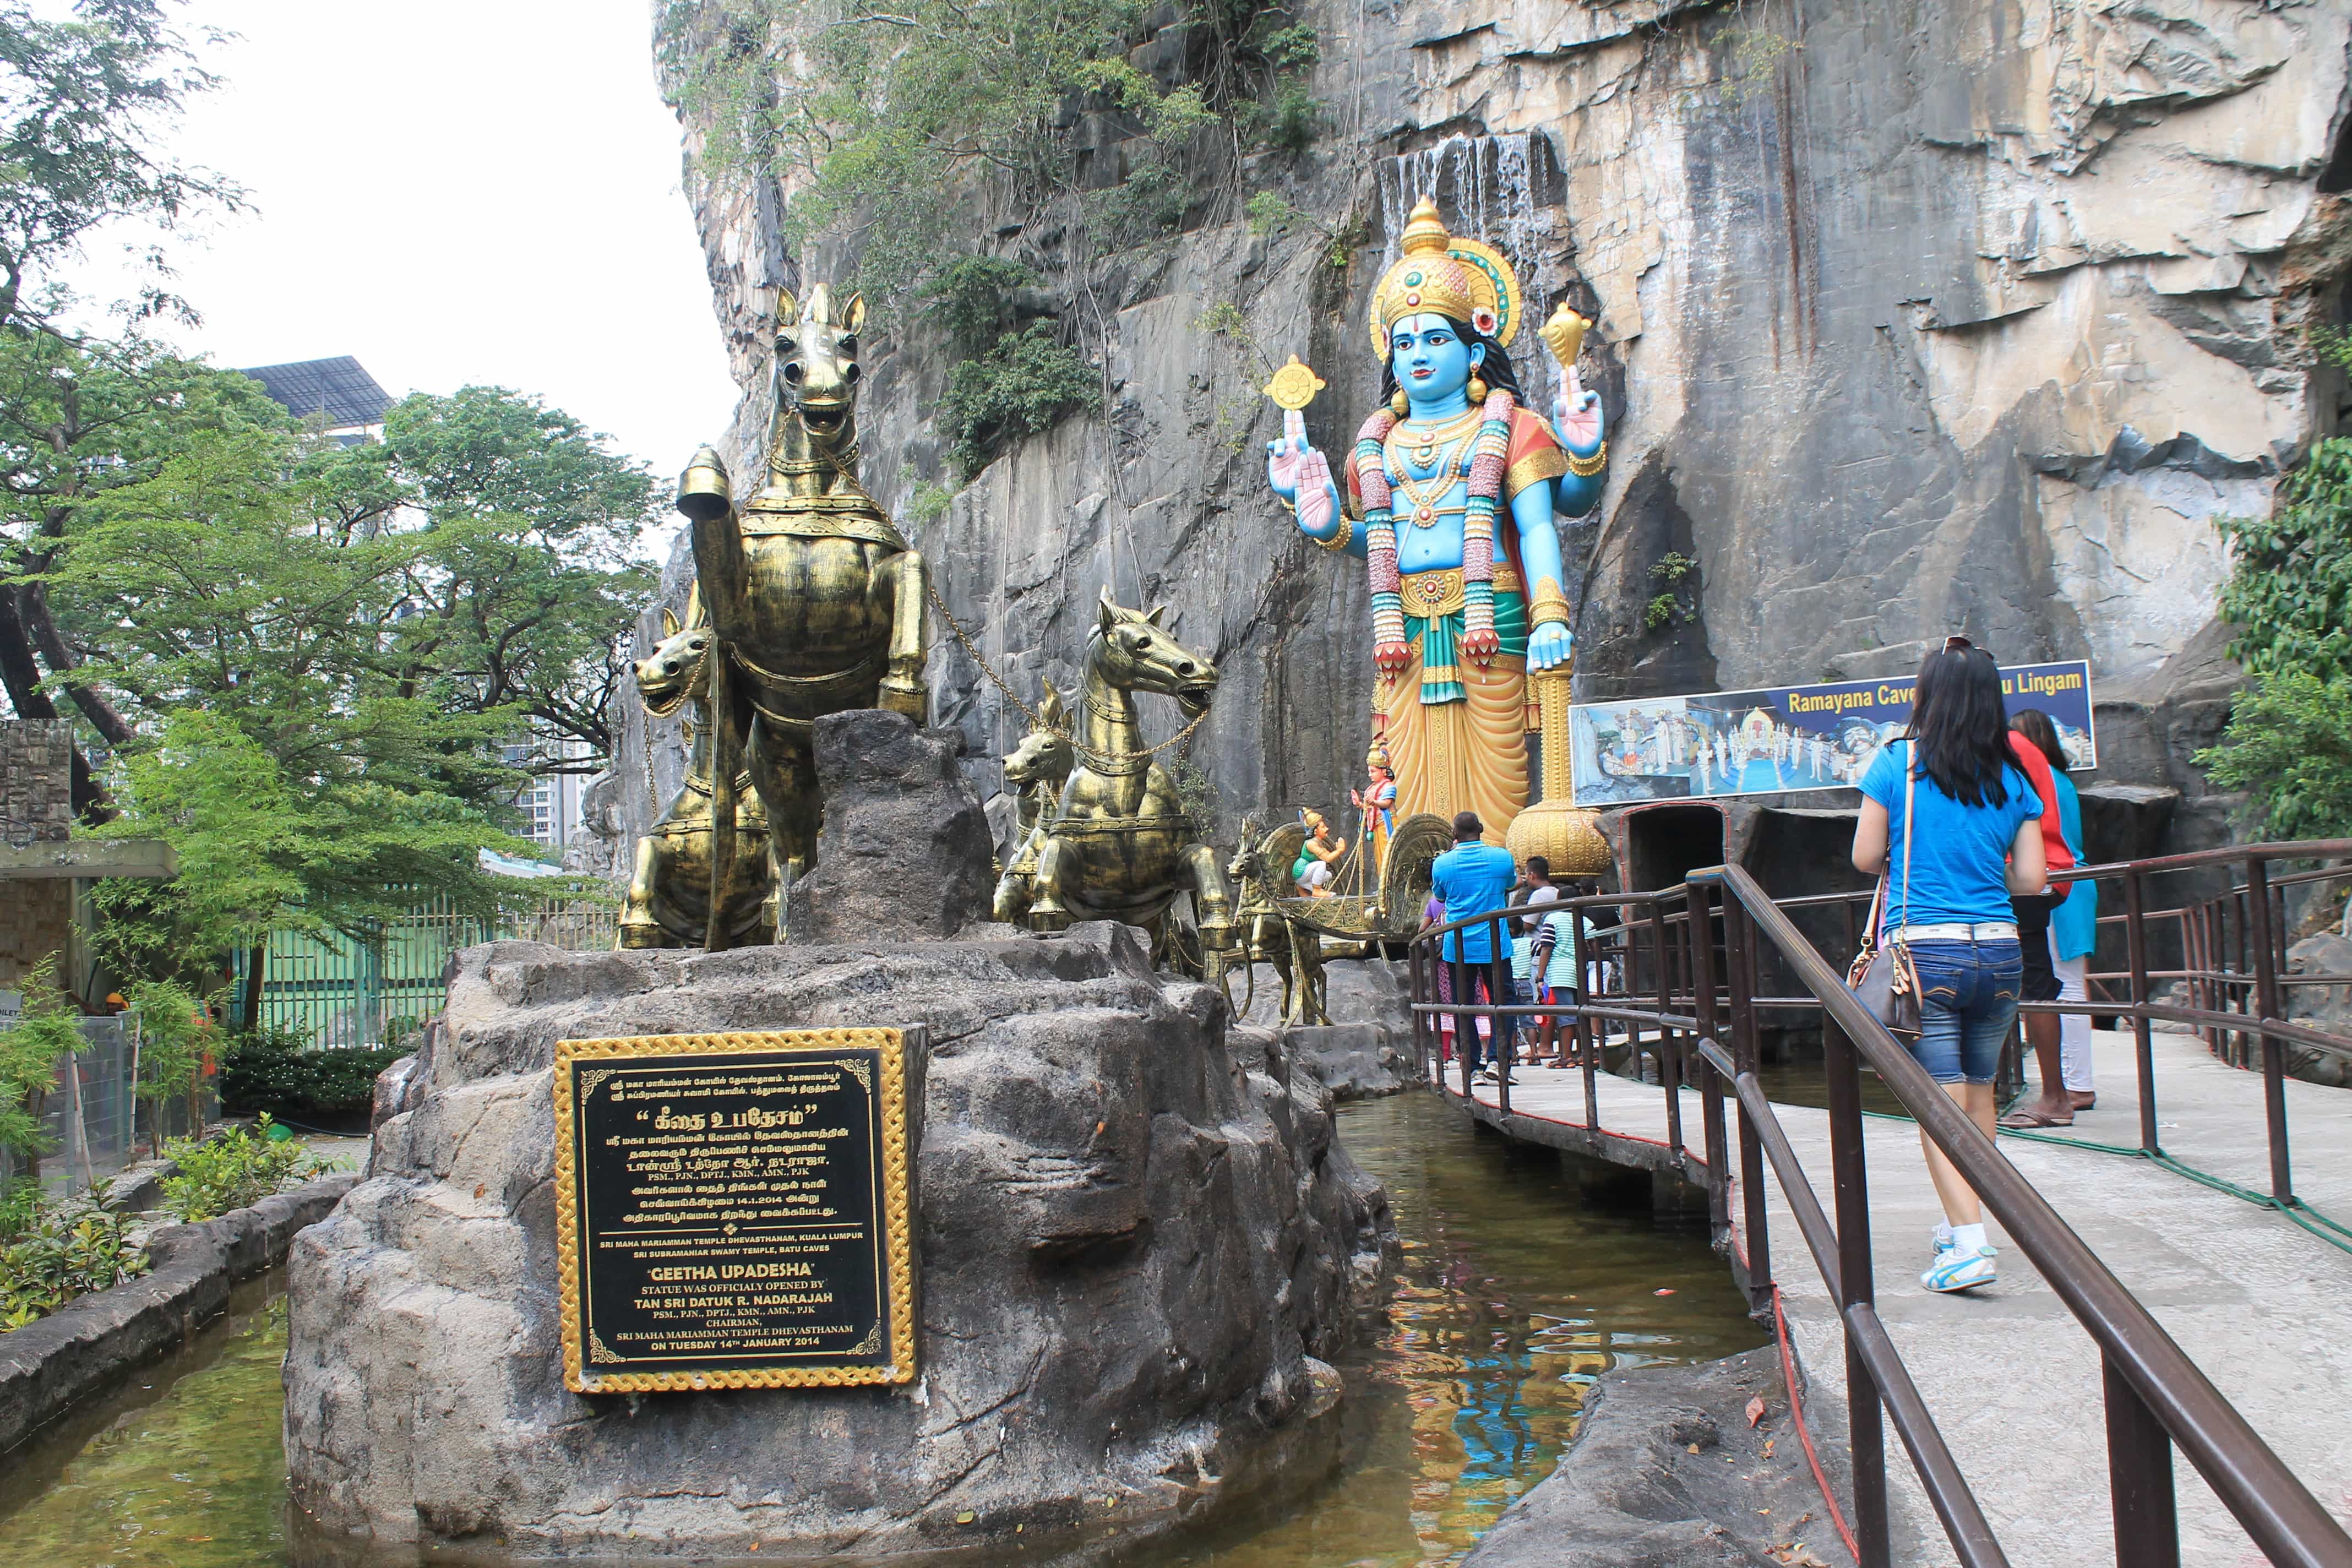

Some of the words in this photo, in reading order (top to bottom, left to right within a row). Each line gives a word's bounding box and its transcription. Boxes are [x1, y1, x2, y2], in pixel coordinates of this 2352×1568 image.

[1788, 690, 1873, 714] Ramayana
[2017, 672, 2082, 696] Lingam
[676, 1171, 698, 1180] PJN.,
[700, 1170, 729, 1179] DPTJ.,
[732, 1169, 759, 1178] KMN.,
[761, 1168, 789, 1177] AMN.,
[728, 1235, 797, 1243] DHEVASTHANAM,
[642, 1286, 682, 1294] STATUE
[709, 1283, 763, 1292] OFFICIALY
[766, 1281, 808, 1290] OPENED
[634, 1299, 660, 1309] TAN
[664, 1298, 685, 1308] SRI
[690, 1297, 733, 1307] DATUK
[737, 1296, 749, 1305] R.
[754, 1292, 832, 1305] NADARAJAH
[706, 1319, 762, 1327] CHAIRMAN,
[666, 1330, 728, 1338] MARIAMMAN
[772, 1325, 853, 1335] DHEVASTHANAM
[669, 1341, 716, 1349] TUESDAY
[743, 1338, 792, 1347] JANUARY
[795, 1337, 819, 1346] 2014
